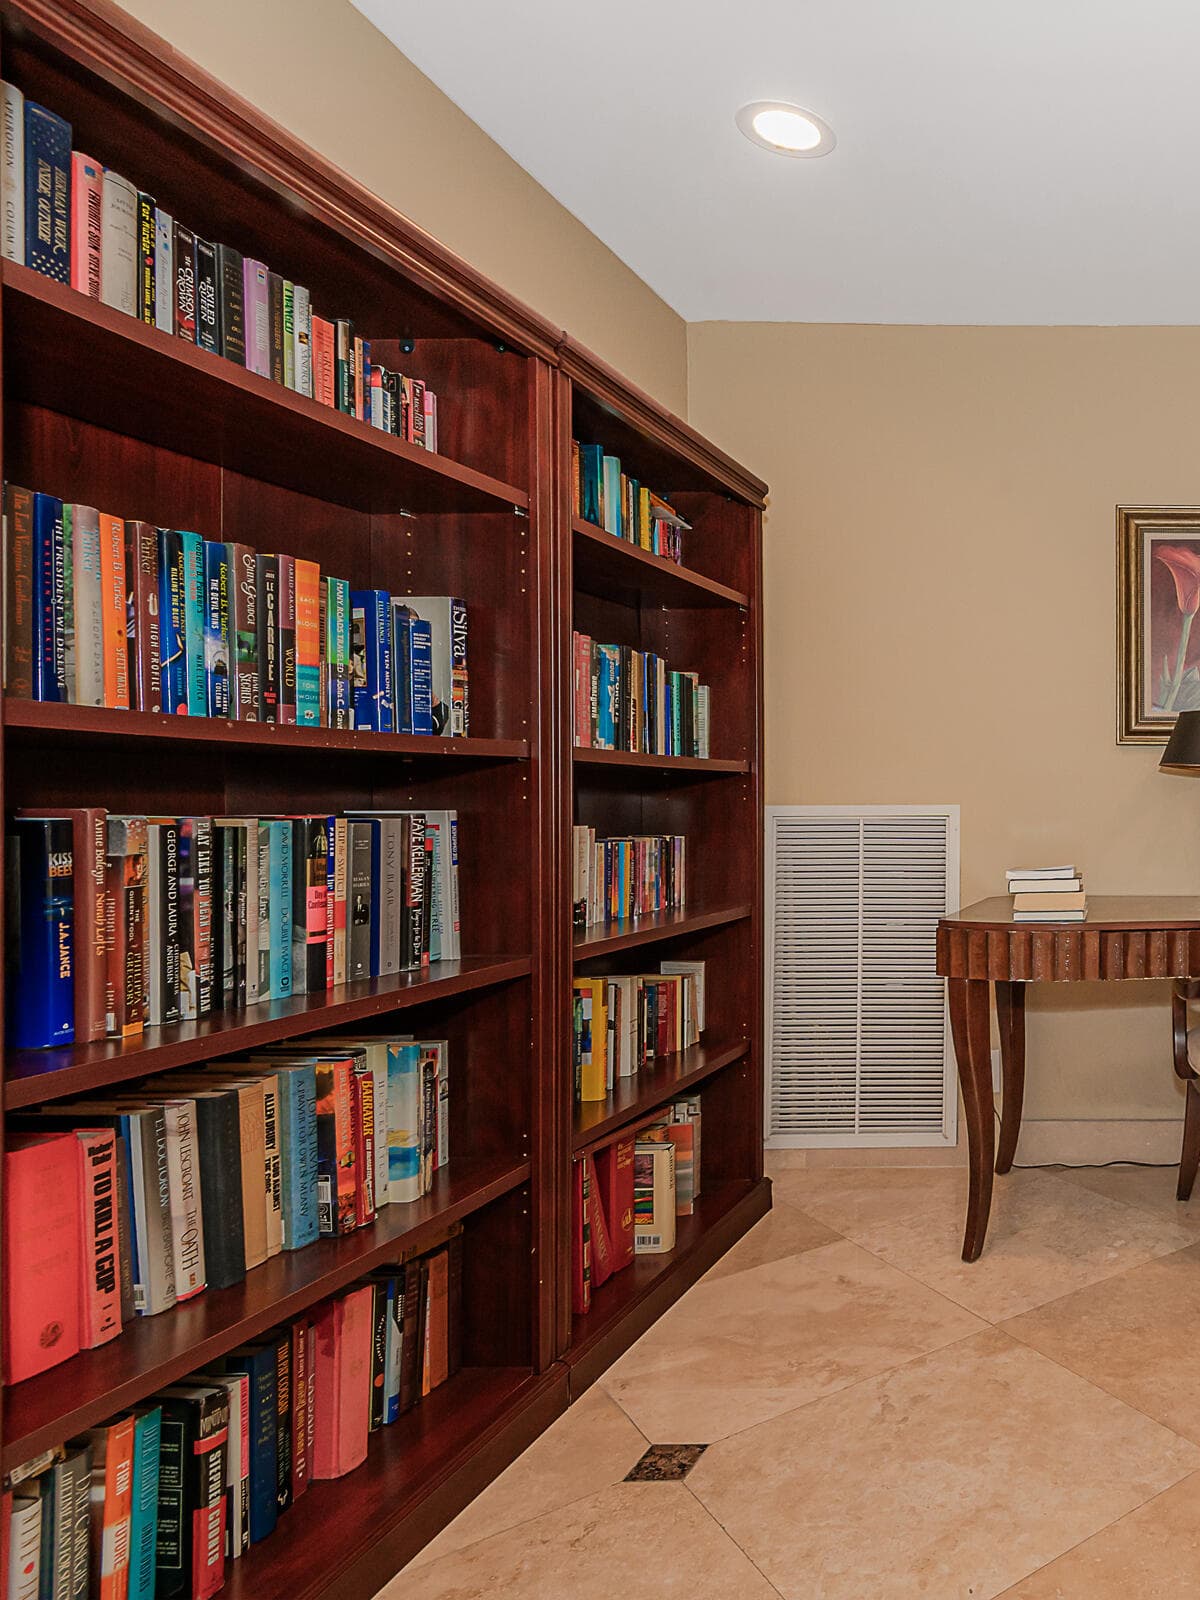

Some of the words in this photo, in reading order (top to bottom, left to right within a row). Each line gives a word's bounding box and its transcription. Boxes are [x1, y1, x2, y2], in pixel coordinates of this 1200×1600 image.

[54, 165, 66, 218] HERMAN
[88, 188, 101, 233] FAVORITE
[53, 216, 66, 258] WOUK
[87, 229, 101, 253] SON
[88, 252, 100, 279] STEVE
[176, 266, 186, 312] CROWN
[184, 266, 194, 323] CRIMSON
[198, 279, 207, 322] QUEEN
[206, 283, 214, 326] EXILED
[55, 518, 63, 542] THE
[56, 545, 64, 612] PRESIDENT
[336, 581, 344, 606] MANY
[56, 614, 64, 634] WE
[150, 623, 159, 648] HIGH
[336, 606, 344, 633] ROADS
[452, 610, 467, 658] Silva
[56, 637, 65, 689] DESERVE
[151, 651, 159, 692] PROFILE
[284, 647, 294, 688] WORLD
[336, 634, 344, 673] TRAVELED
[386, 832, 395, 869] TONY
[411, 818, 424, 843] FAYE
[167, 830, 177, 873] GEORGE
[168, 875, 177, 899] AND
[386, 873, 396, 907] BLAIR
[411, 844, 425, 903] KELLERMAN
[168, 902, 178, 936] LAURA
[125, 951, 134, 1006] GREGORY
[133, 951, 142, 1005] PHILIPPA
[264, 1091, 275, 1121] ALLEN
[361, 1078, 374, 1137] BARRAYAR
[177, 1112, 191, 1143] JOHN
[265, 1119, 276, 1152] DRURY
[94, 1167, 112, 1197] TO
[179, 1142, 194, 1202] LESCROART
[94, 1195, 112, 1239] KILL
[187, 1209, 196, 1228] THE
[94, 1235, 112, 1257] A
[181, 1227, 199, 1271] OATH
[94, 1252, 115, 1298] COP
[141, 1423, 159, 1458] DICK
[74, 1473, 91, 1518] DALE
[115, 1458, 130, 1497] FIRM
[140, 1454, 158, 1513] FRANCIS
[208, 1449, 222, 1510] STEPHEN
[113, 1517, 129, 1569] FUTURE
